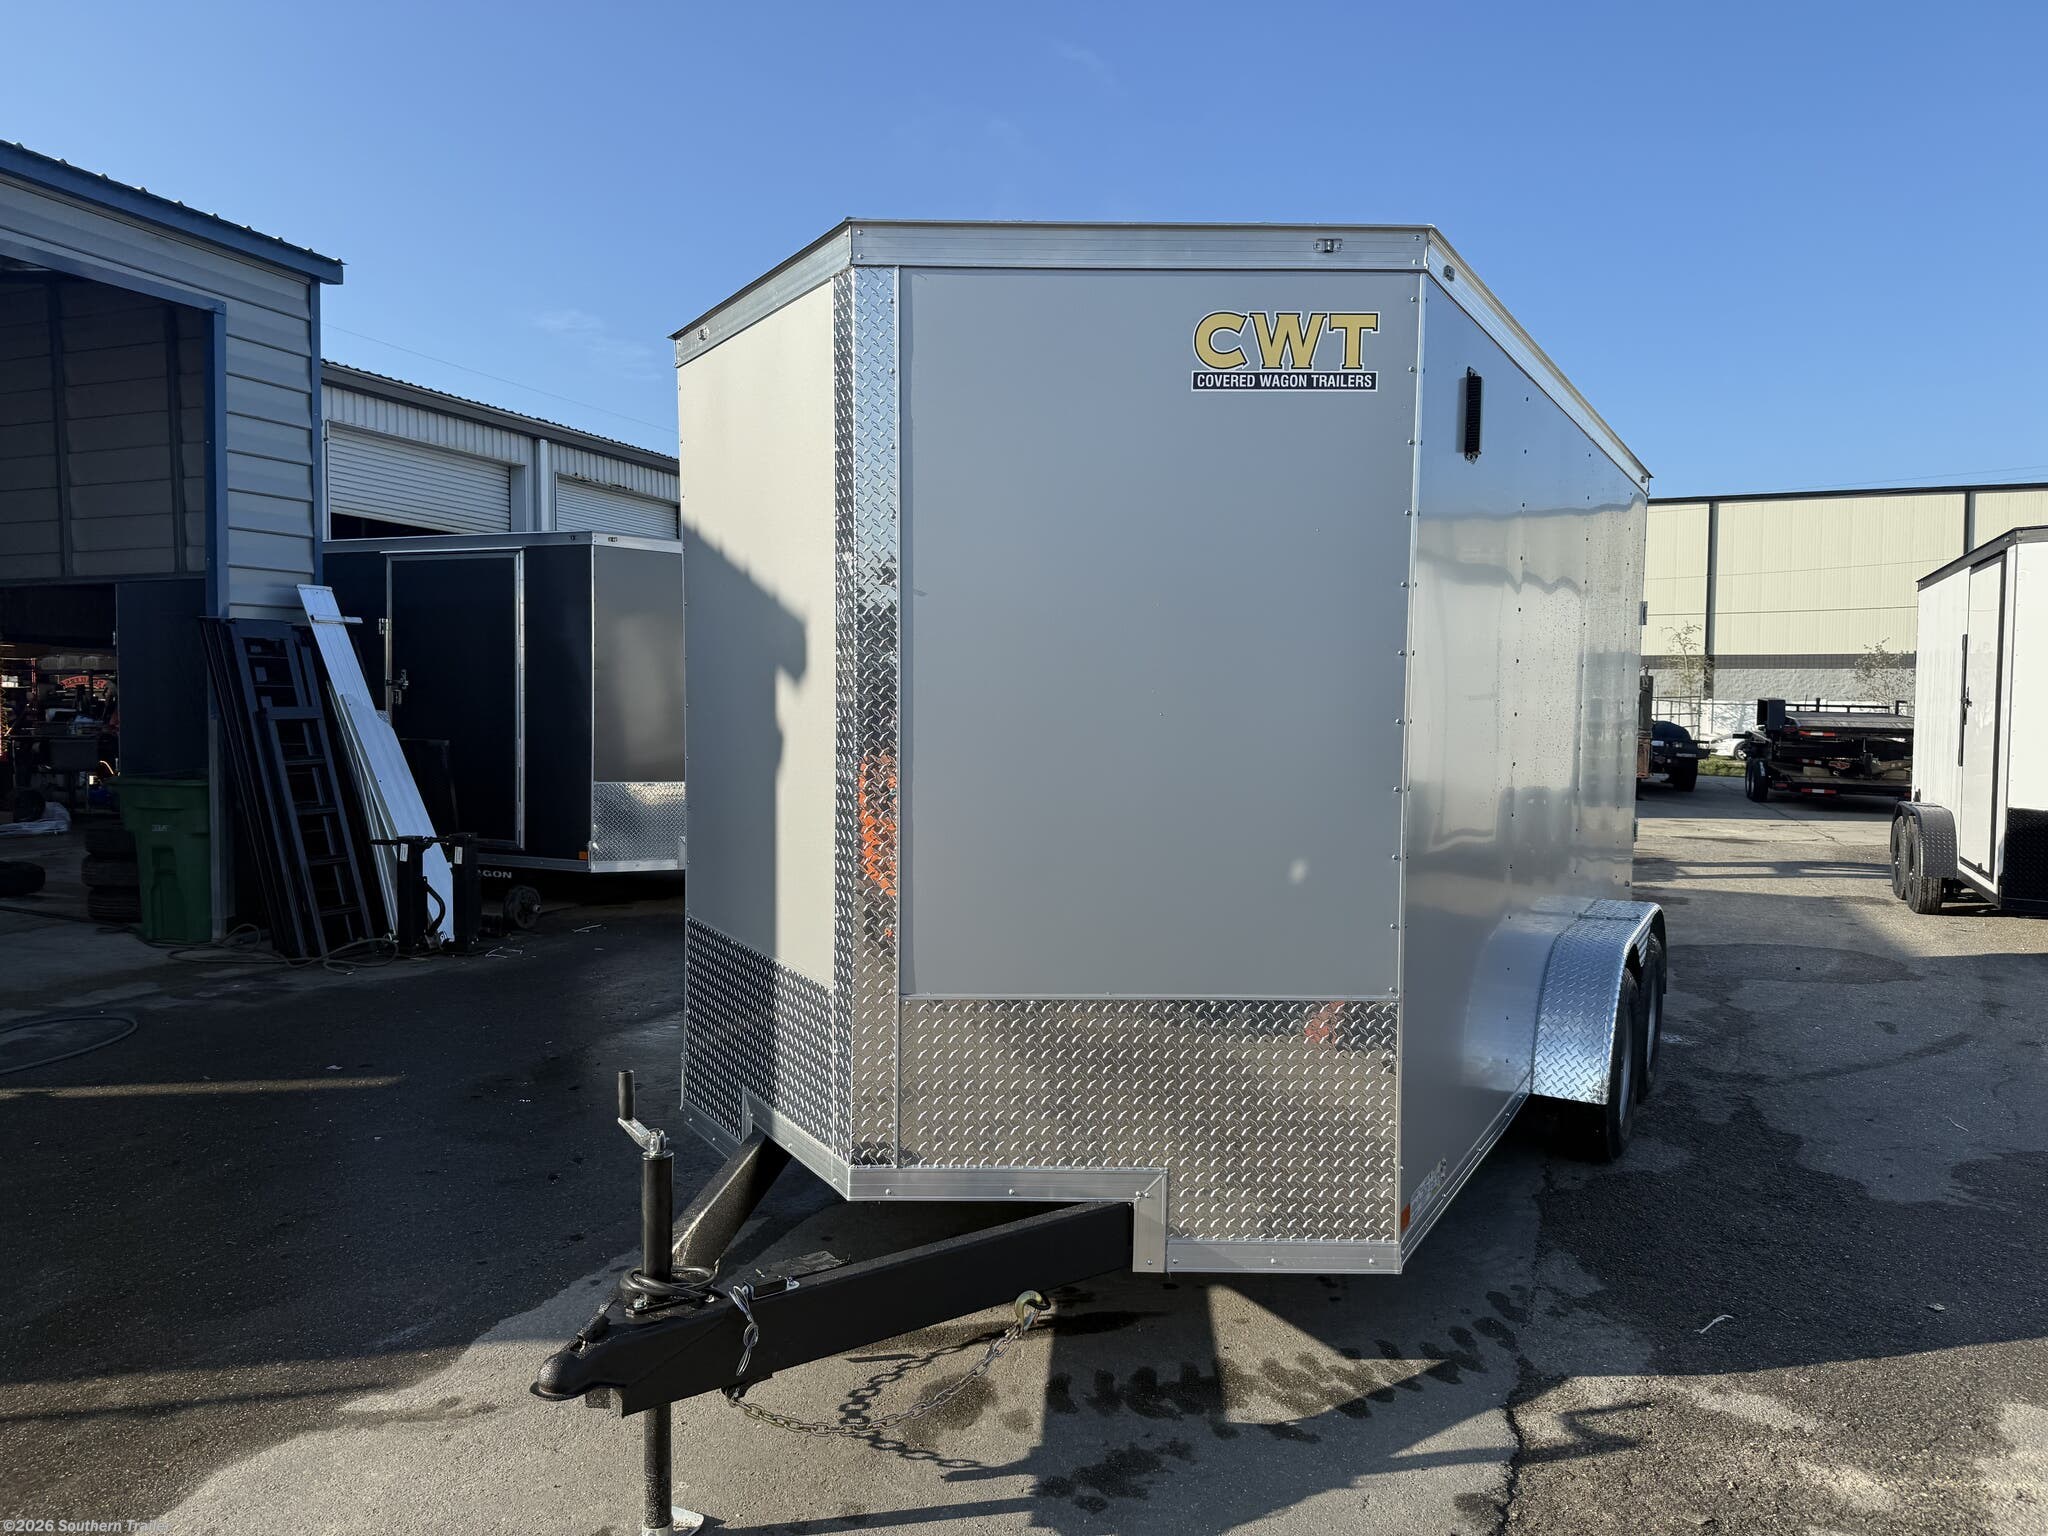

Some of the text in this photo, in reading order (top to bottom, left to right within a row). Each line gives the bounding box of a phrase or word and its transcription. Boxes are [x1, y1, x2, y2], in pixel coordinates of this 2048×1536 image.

[1194, 311, 1379, 370] CWT
[1197, 374, 1373, 388] COVERED WAGON TRAILERS
